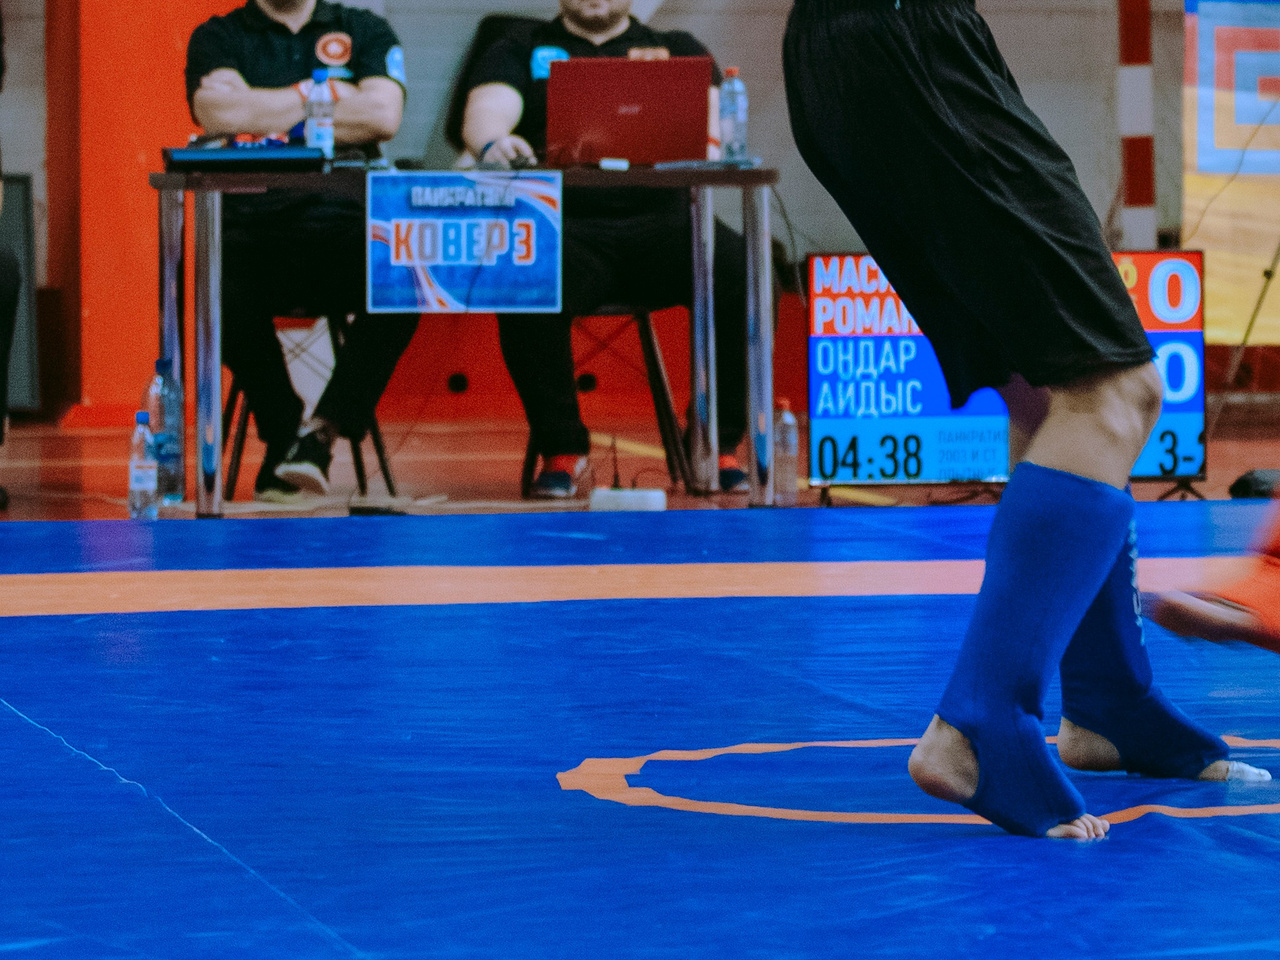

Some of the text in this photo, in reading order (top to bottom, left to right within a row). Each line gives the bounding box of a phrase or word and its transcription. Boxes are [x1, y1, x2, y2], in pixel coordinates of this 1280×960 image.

[392, 220, 534, 263] КОВЕР 3
[1148, 258, 1201, 324] 0
[1153, 342, 1199, 404] 0
[818, 434, 922, 479] 04:38
